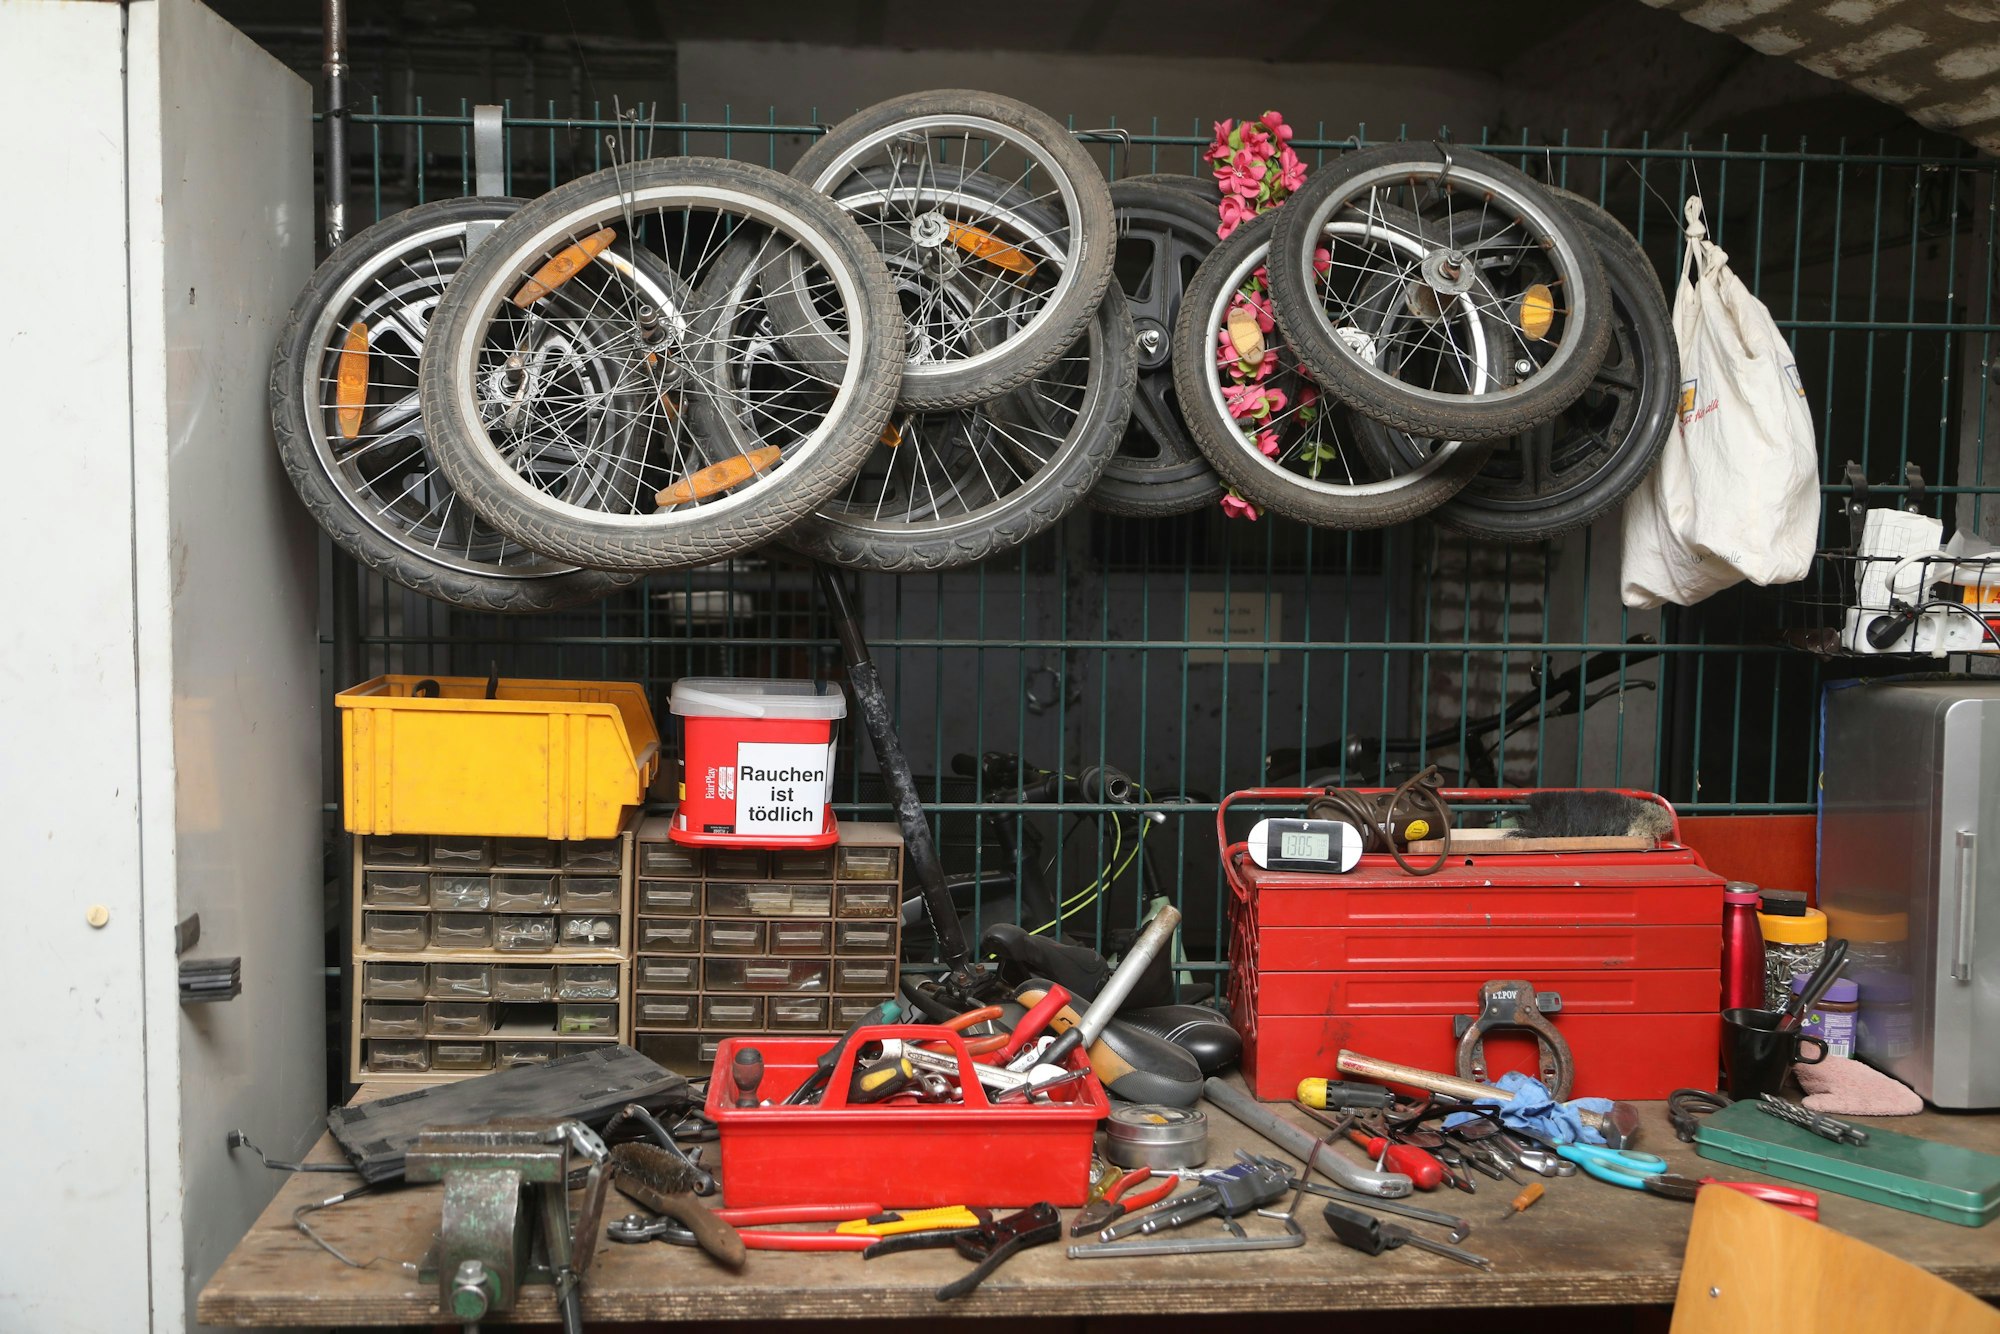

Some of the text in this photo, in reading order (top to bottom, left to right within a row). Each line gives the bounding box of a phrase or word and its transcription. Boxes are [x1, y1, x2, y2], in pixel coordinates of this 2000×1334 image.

[740, 765, 824, 782] Rauchen
[771, 786, 794, 802] ist
[748, 805, 813, 822] tödlich
